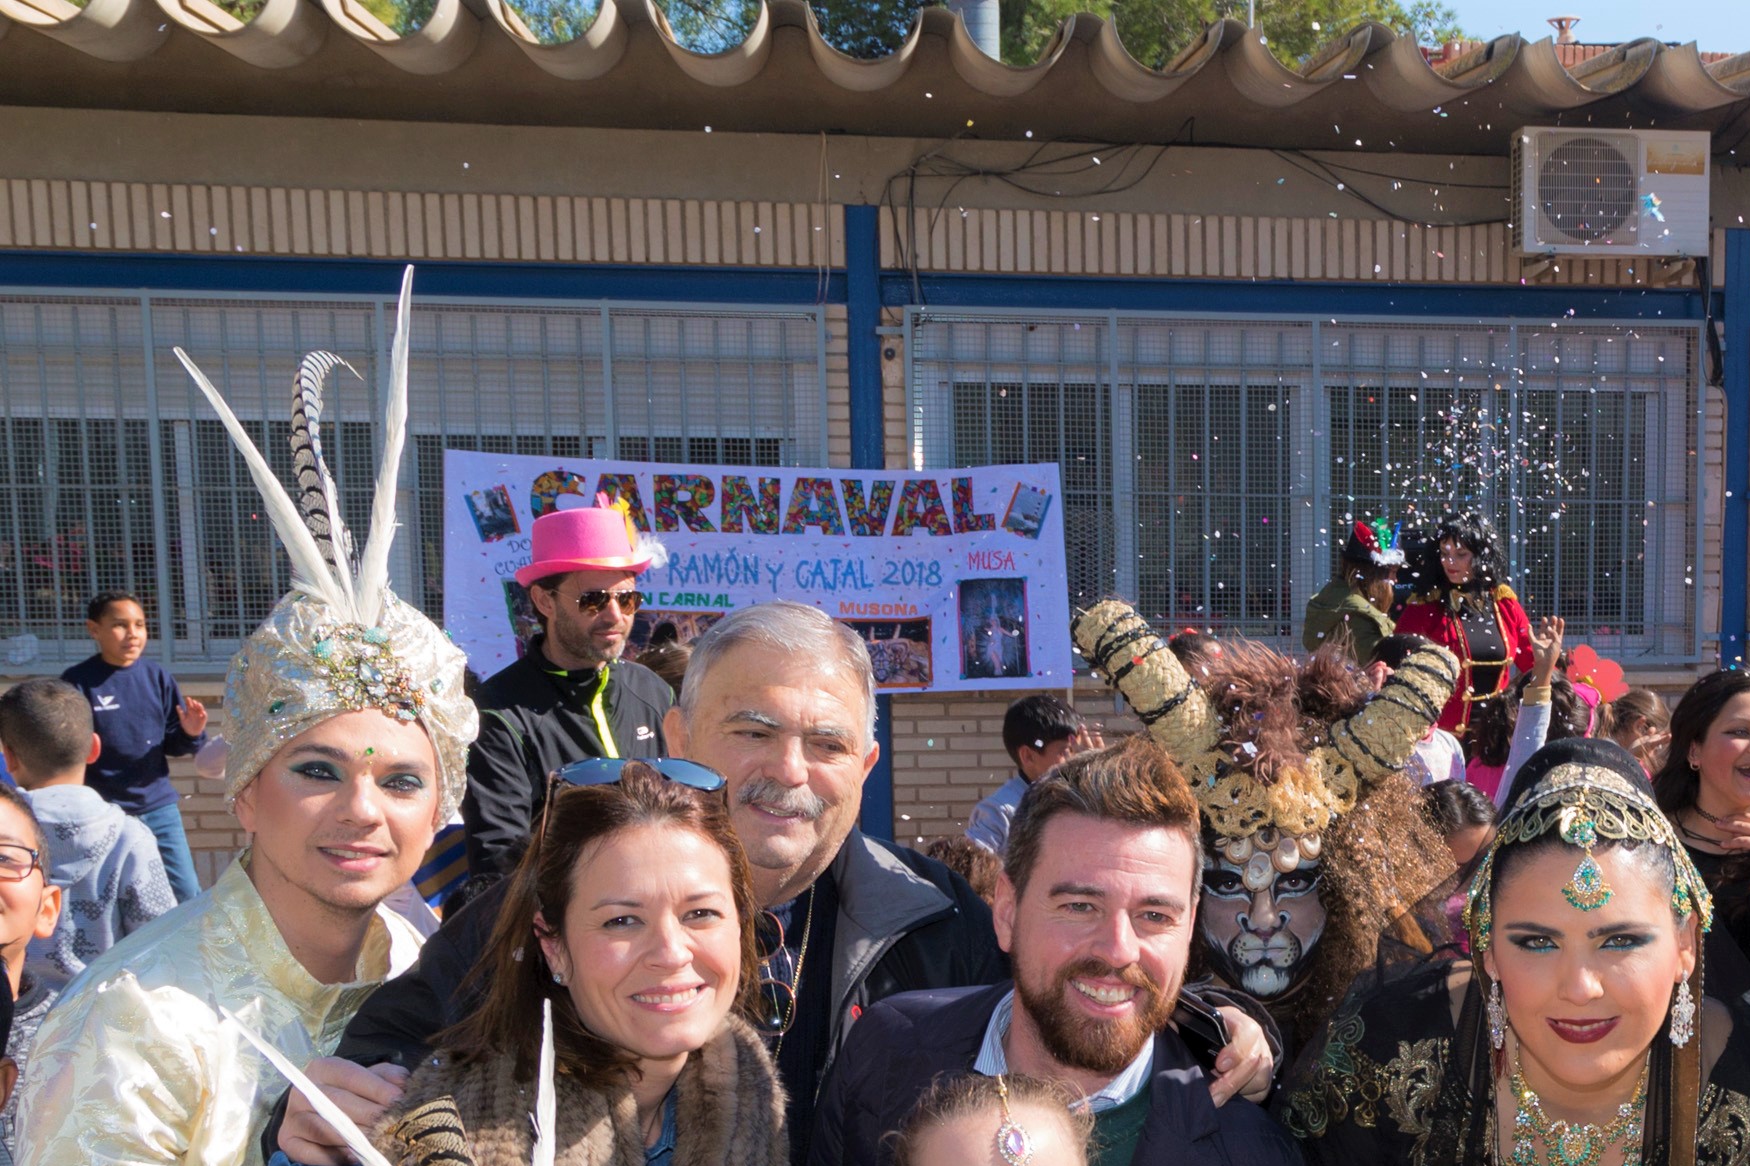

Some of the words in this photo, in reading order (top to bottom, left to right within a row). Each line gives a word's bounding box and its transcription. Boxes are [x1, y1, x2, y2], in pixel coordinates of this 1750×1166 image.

[530, 470, 996, 537] CARNAVAL
[968, 551, 1015, 571] MUSA
[796, 558, 874, 591] CAJAL
[881, 559, 943, 588] 2018
[659, 591, 734, 608] CARNAL
[839, 601, 918, 616] MUSONA
